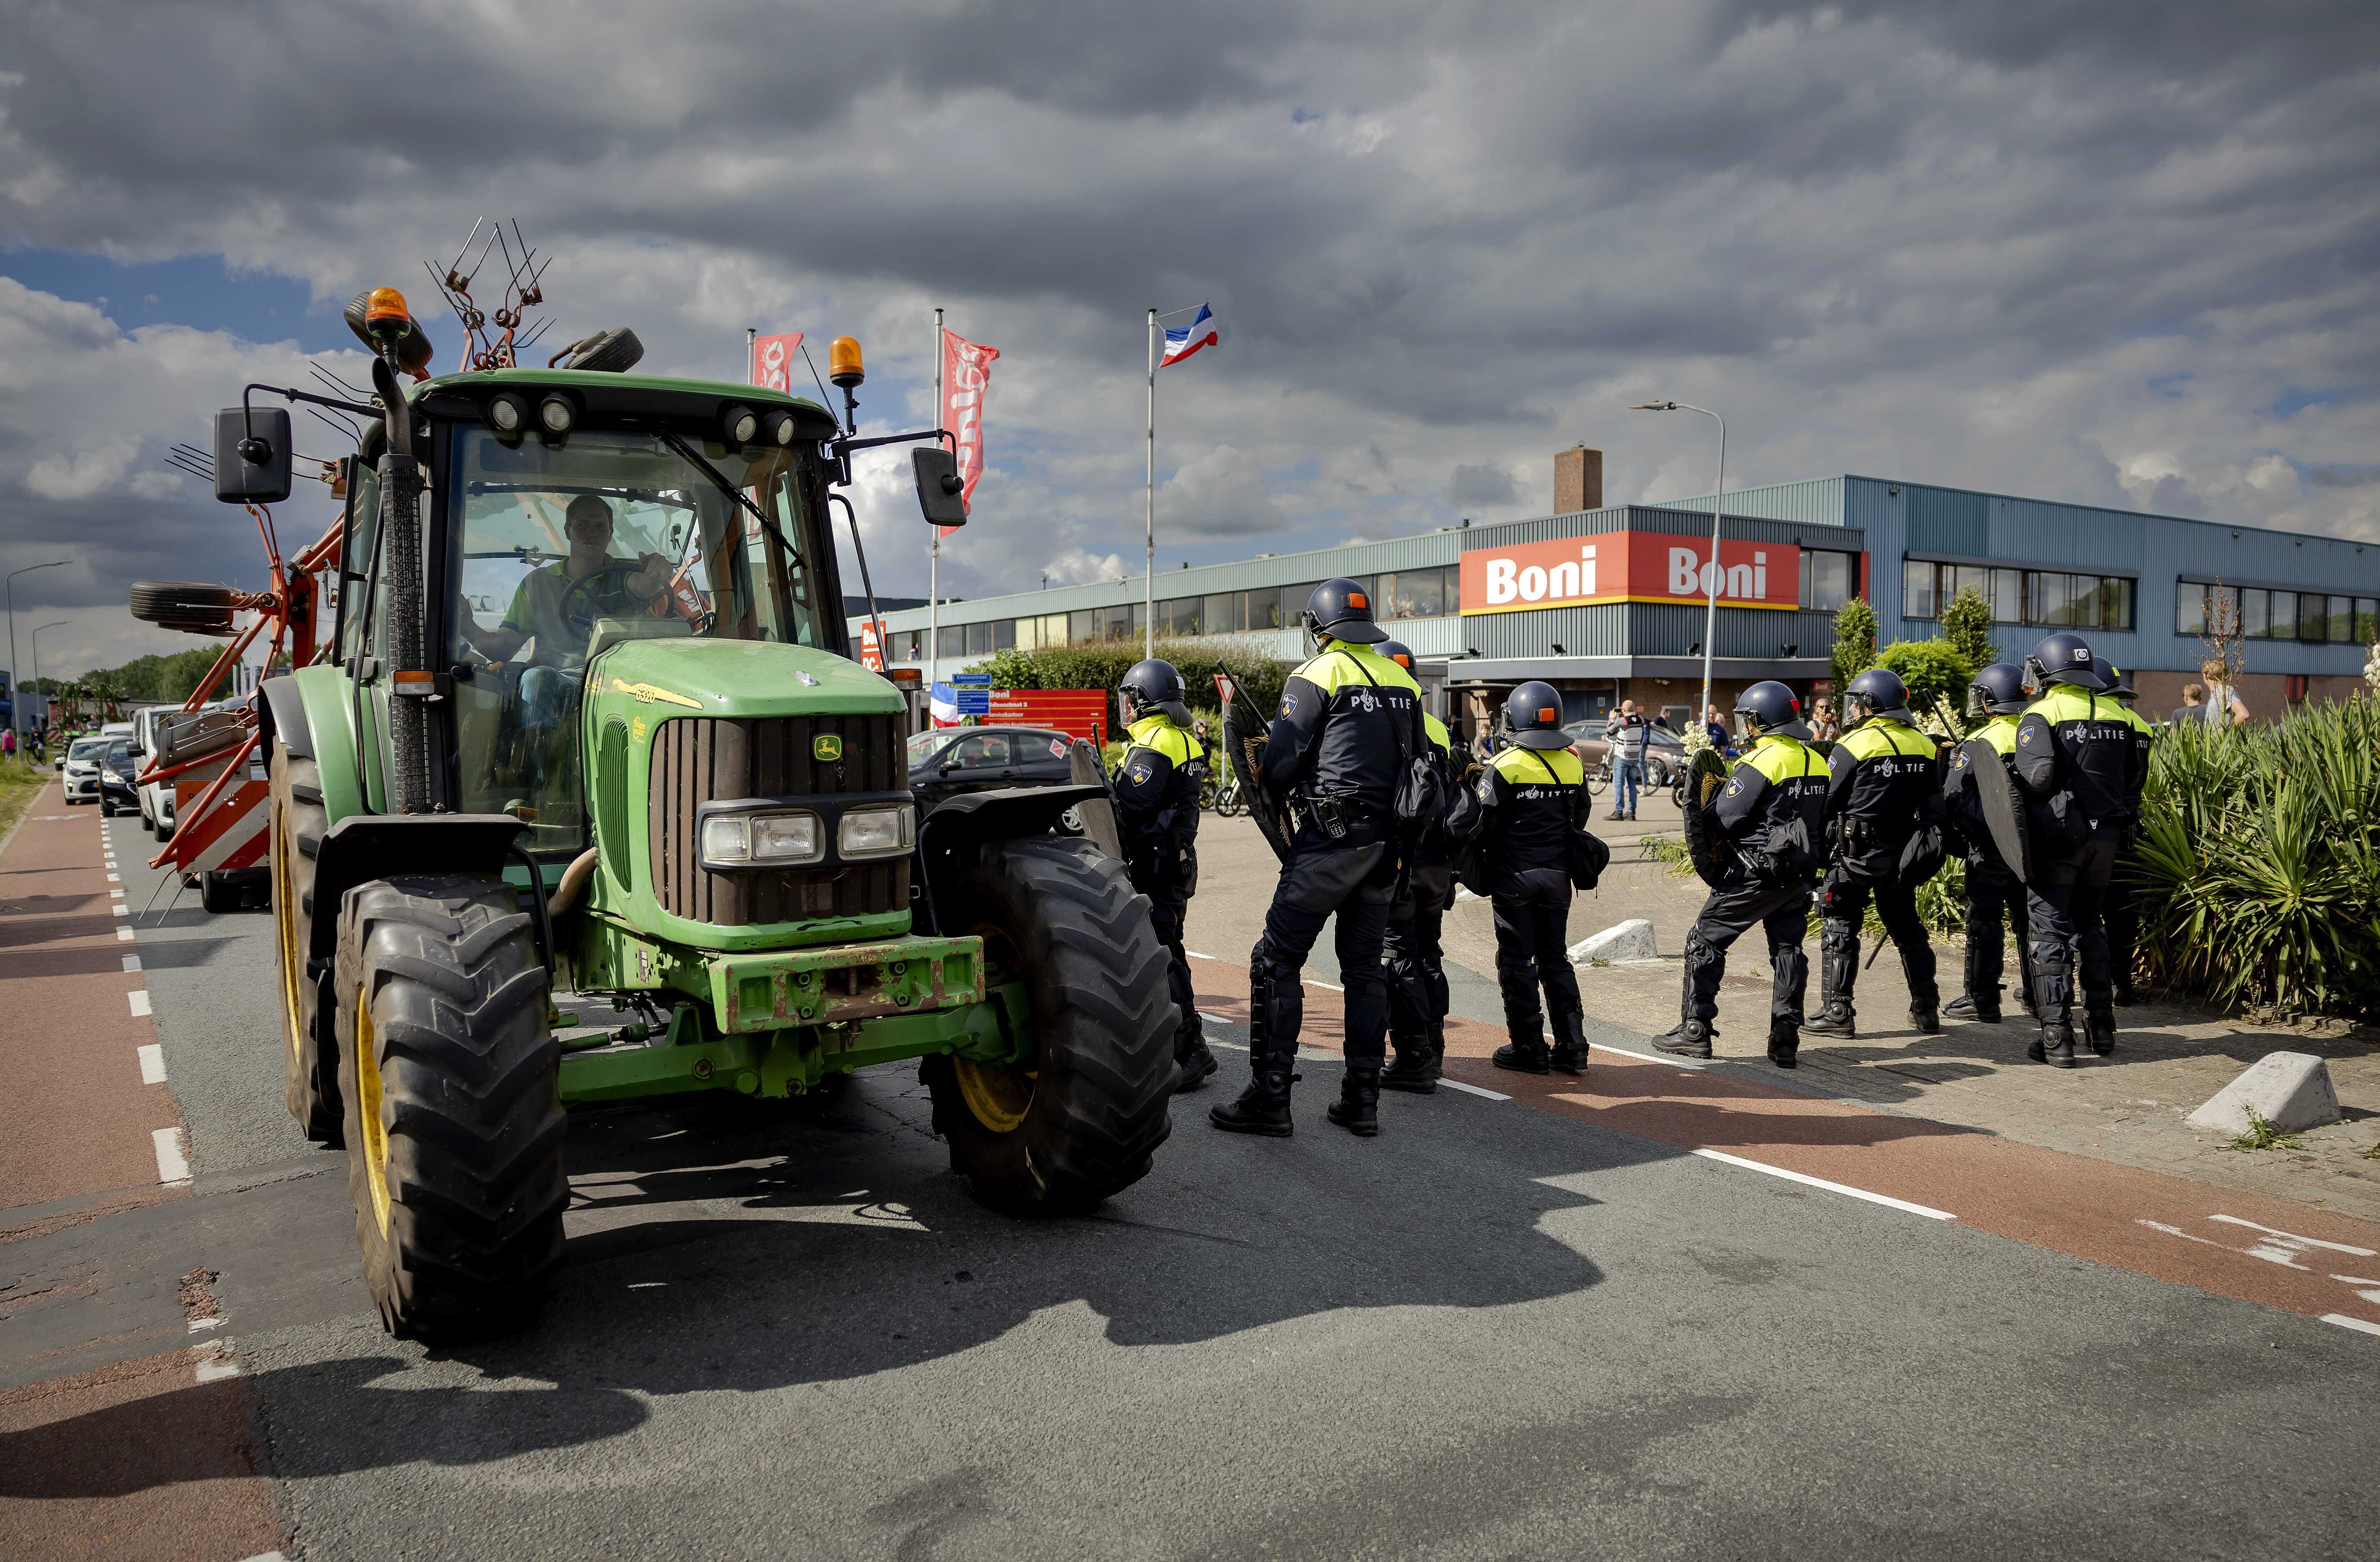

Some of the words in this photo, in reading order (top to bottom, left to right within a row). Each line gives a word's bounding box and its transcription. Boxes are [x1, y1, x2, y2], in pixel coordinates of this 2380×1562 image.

[950, 389, 979, 489] oni
[1487, 544, 1596, 604] Boni
[1669, 547, 1766, 599] Boni
[636, 686, 656, 704] 6320
[1351, 687, 1411, 712] POLTIE
[1134, 765, 1151, 774] POLITIE
[1874, 757, 1925, 777] POLTIE
